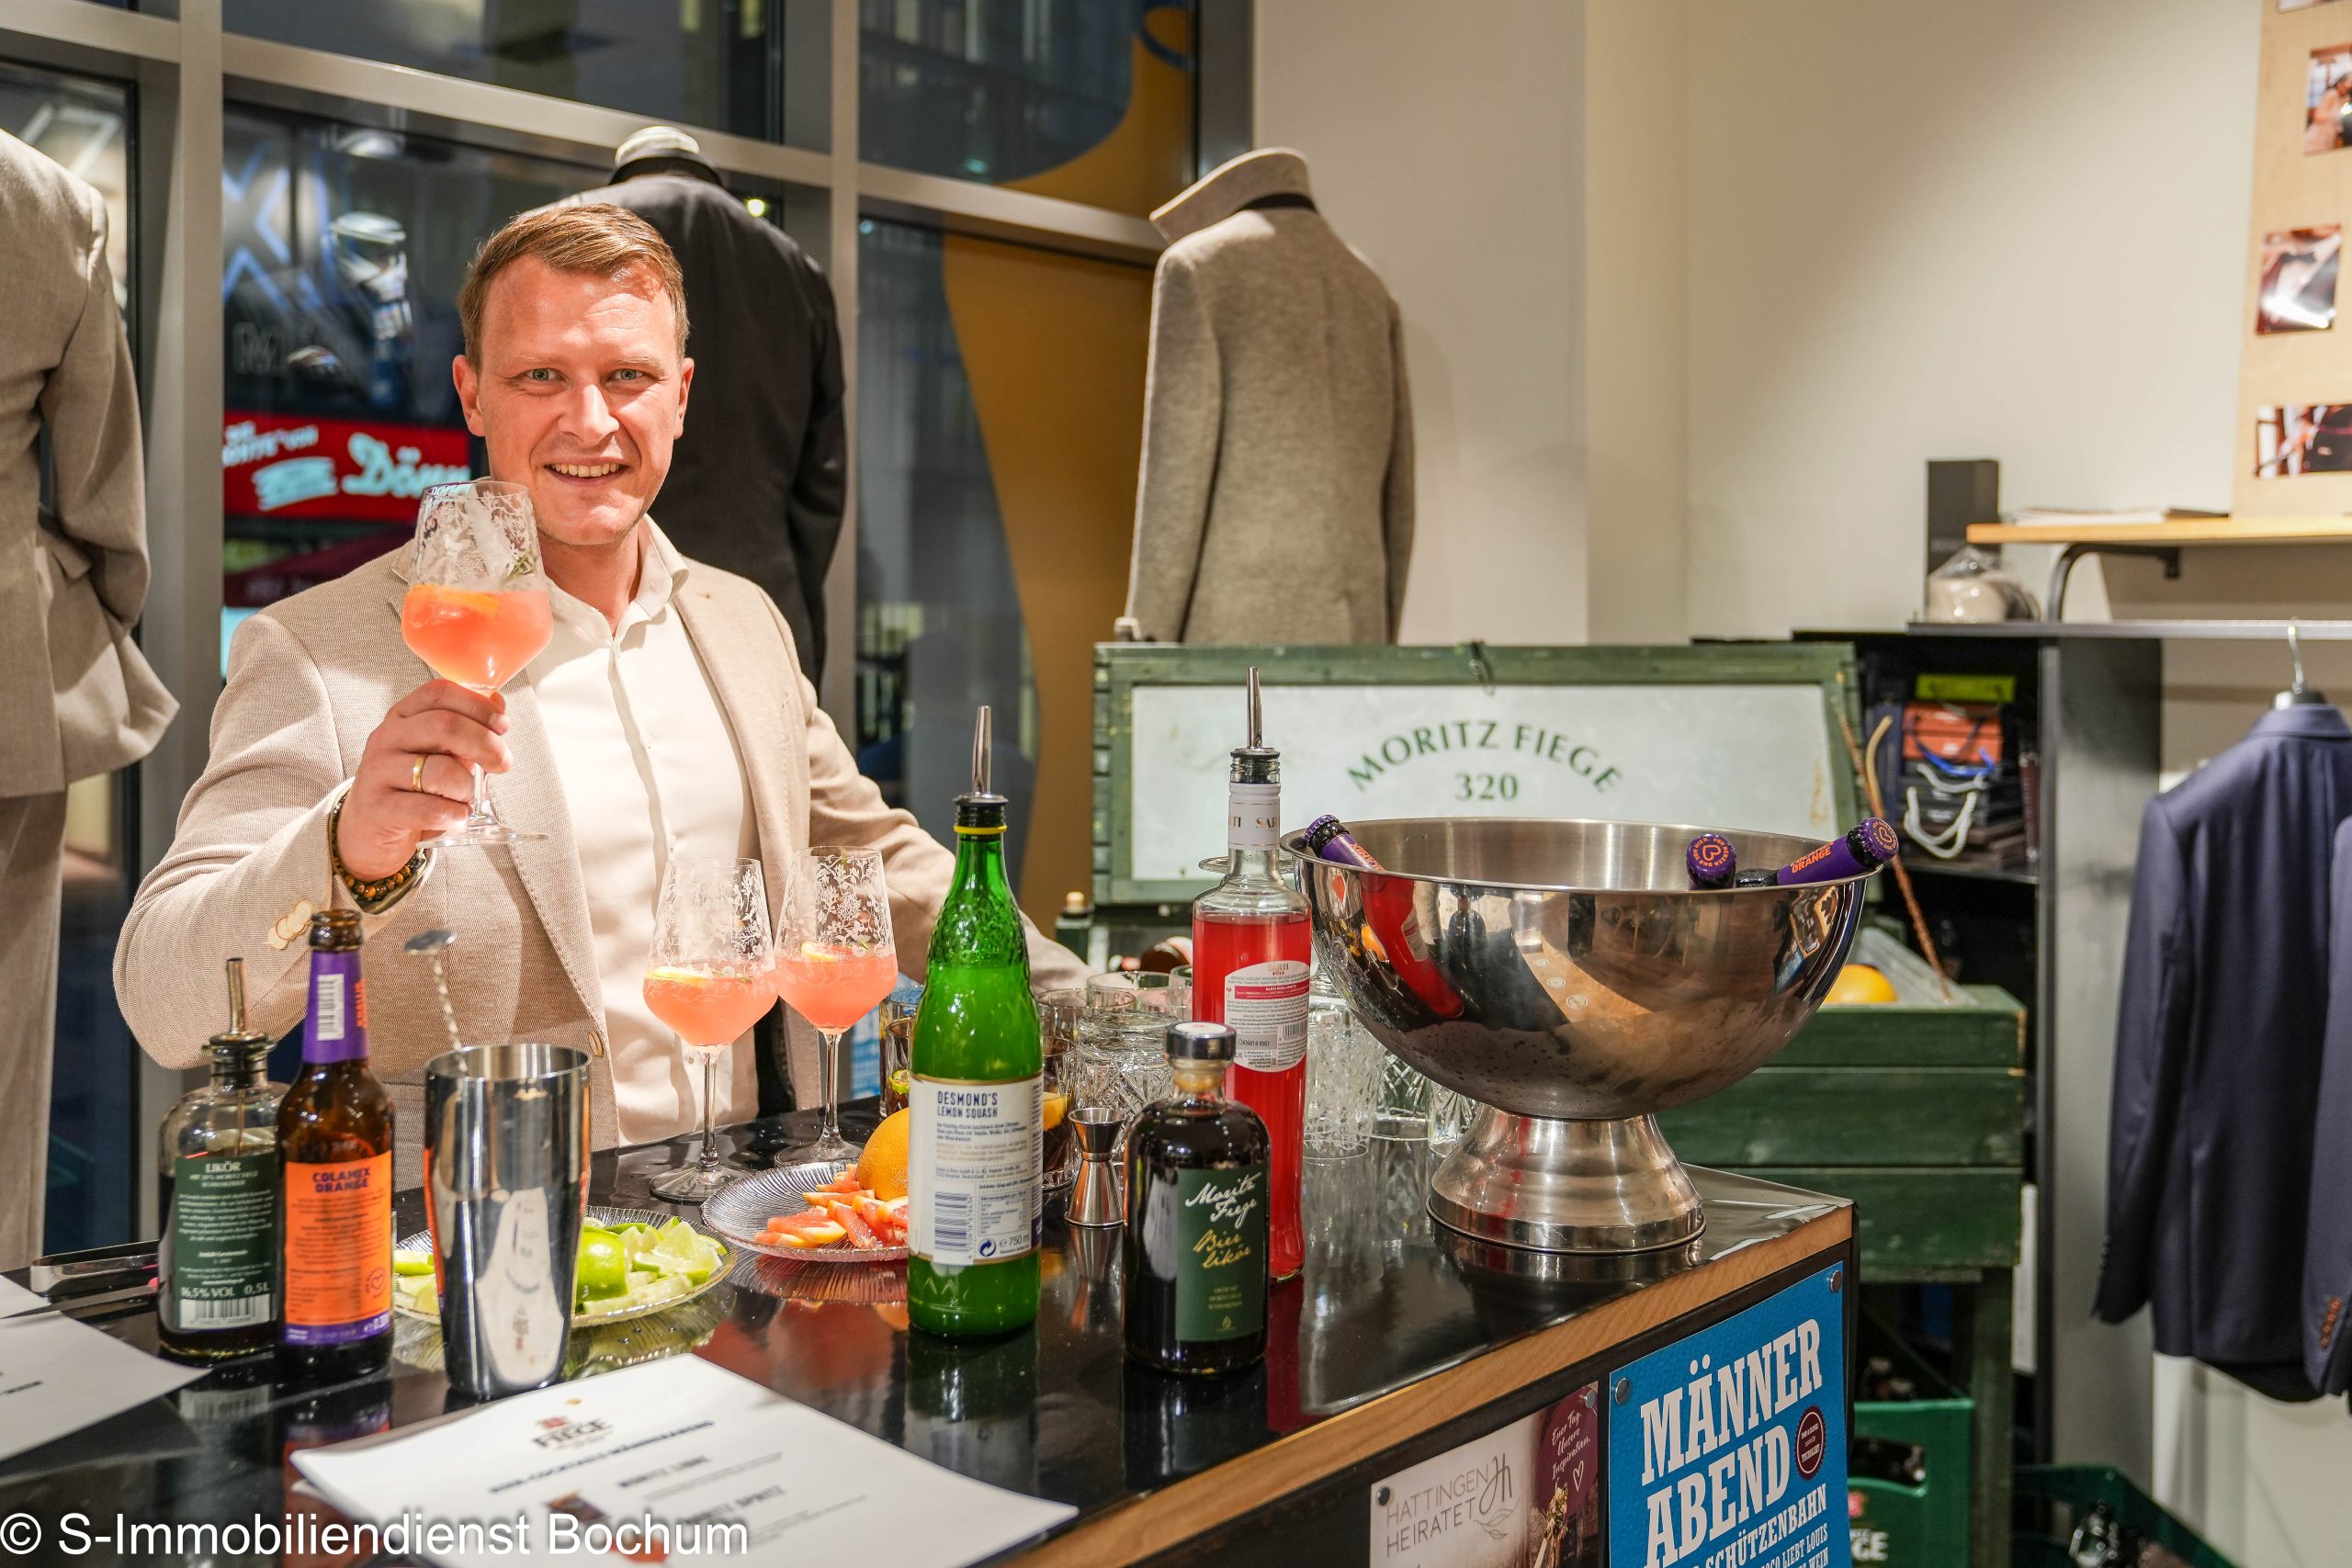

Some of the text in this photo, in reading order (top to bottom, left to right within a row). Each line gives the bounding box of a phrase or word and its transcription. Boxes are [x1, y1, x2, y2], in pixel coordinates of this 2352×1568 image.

[1346, 720, 1623, 794] MORITZ FIEGE
[1454, 773, 1520, 802] 320
[1792, 846, 1831, 874] ORANGE
[937, 1090, 998, 1106] DESMOND'S
[937, 1106, 998, 1119] LEMON SQUASH
[205, 1161, 241, 1173] LIKÖR
[313, 1168, 370, 1182] COLAMIX
[315, 1179, 369, 1193] ORANGE
[1184, 1171, 1262, 1208] Moritz
[1209, 1196, 1258, 1230] Fiege
[1193, 1228, 1242, 1253] Bier
[210, 1286, 235, 1297] VOL
[1640, 1318, 1823, 1487] MÄNNER
[1552, 1423, 1568, 1446] Euer
[1557, 1427, 1580, 1456] Unsere
[1386, 1462, 1488, 1529] HATTINGEN
[1644, 1425, 1790, 1568] ABEND
[1386, 1496, 1476, 1558] HEIRATET
[1782, 1539, 1804, 1568] LIEBT
[1806, 1522, 1828, 1553] LOUIS
